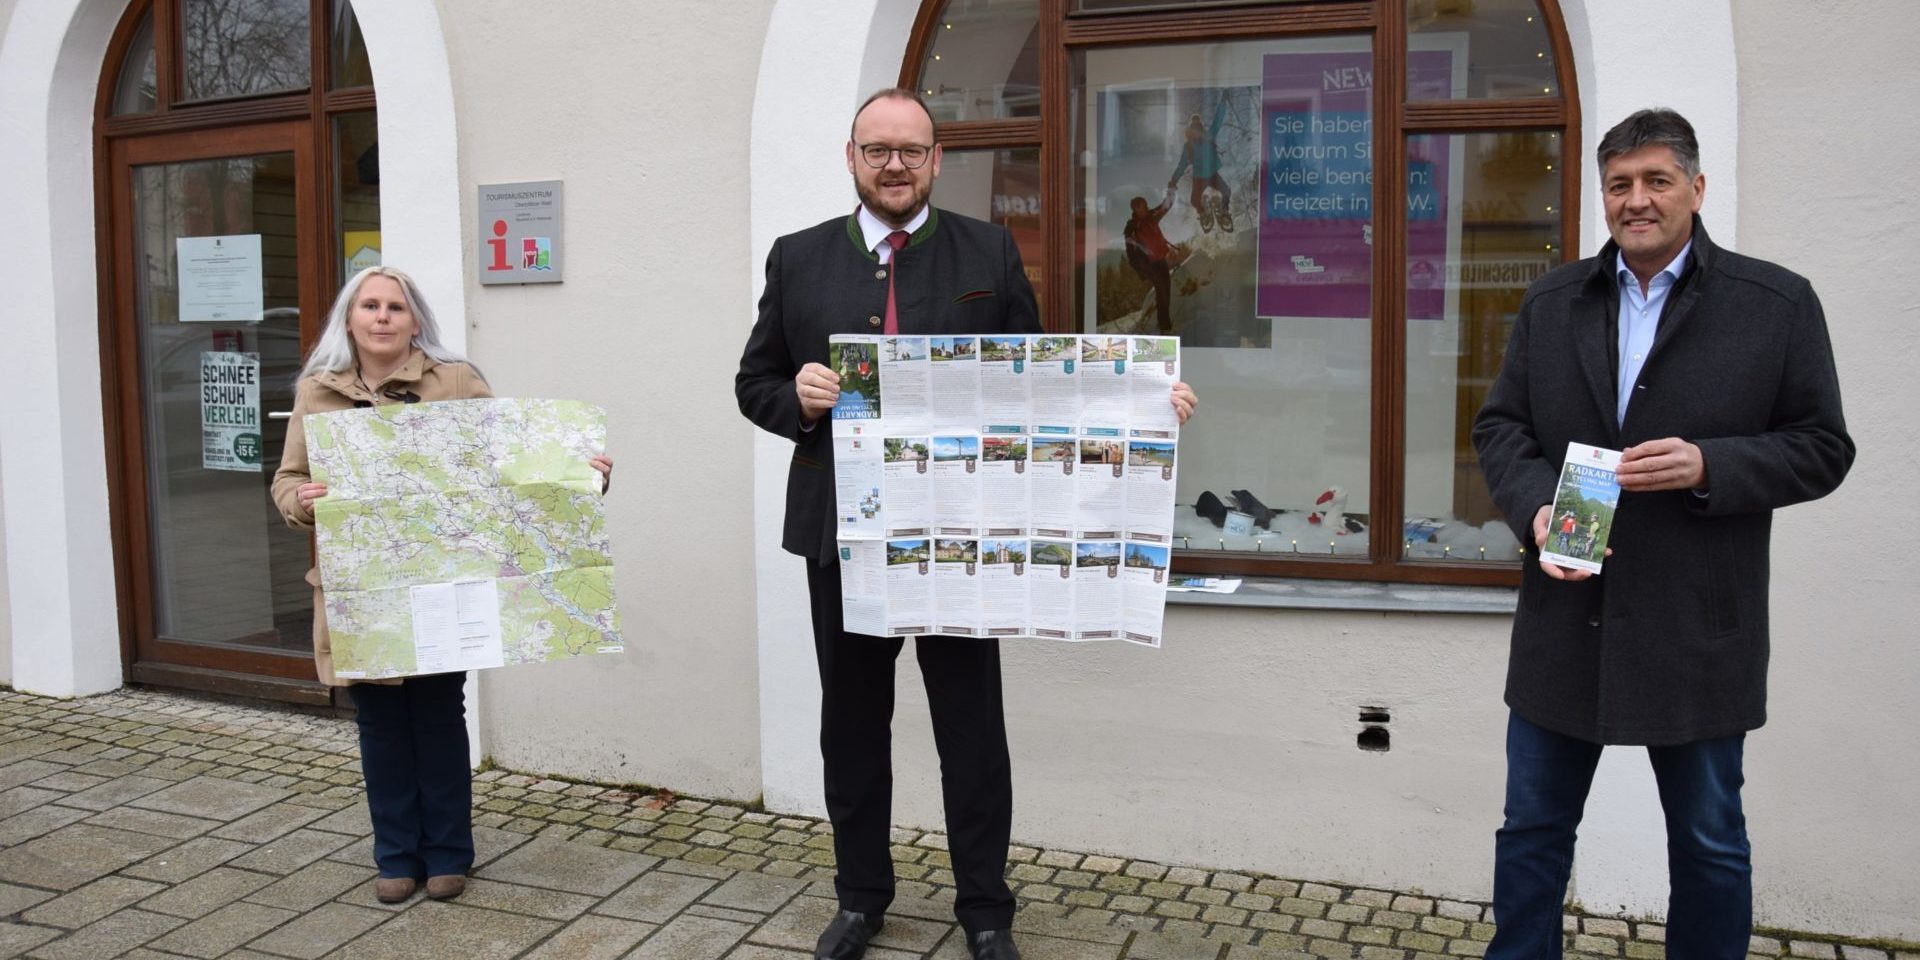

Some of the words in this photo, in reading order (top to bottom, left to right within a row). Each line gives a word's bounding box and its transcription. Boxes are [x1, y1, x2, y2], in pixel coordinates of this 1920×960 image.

[1274, 116, 1304, 134] Sie
[1274, 145, 1347, 160] worum
[1354, 142, 1373, 160] Si
[1273, 167, 1318, 185] viele
[486, 191, 552, 201] TOURISMUSZENTRUM
[1273, 193, 1343, 211] Freizeit
[1351, 193, 1368, 211] in
[203, 365, 255, 384] SCHNEE
[203, 385, 246, 405] SCHUH
[204, 406, 256, 425] VERLEIH
[836, 410, 878, 419] RADKARTE
